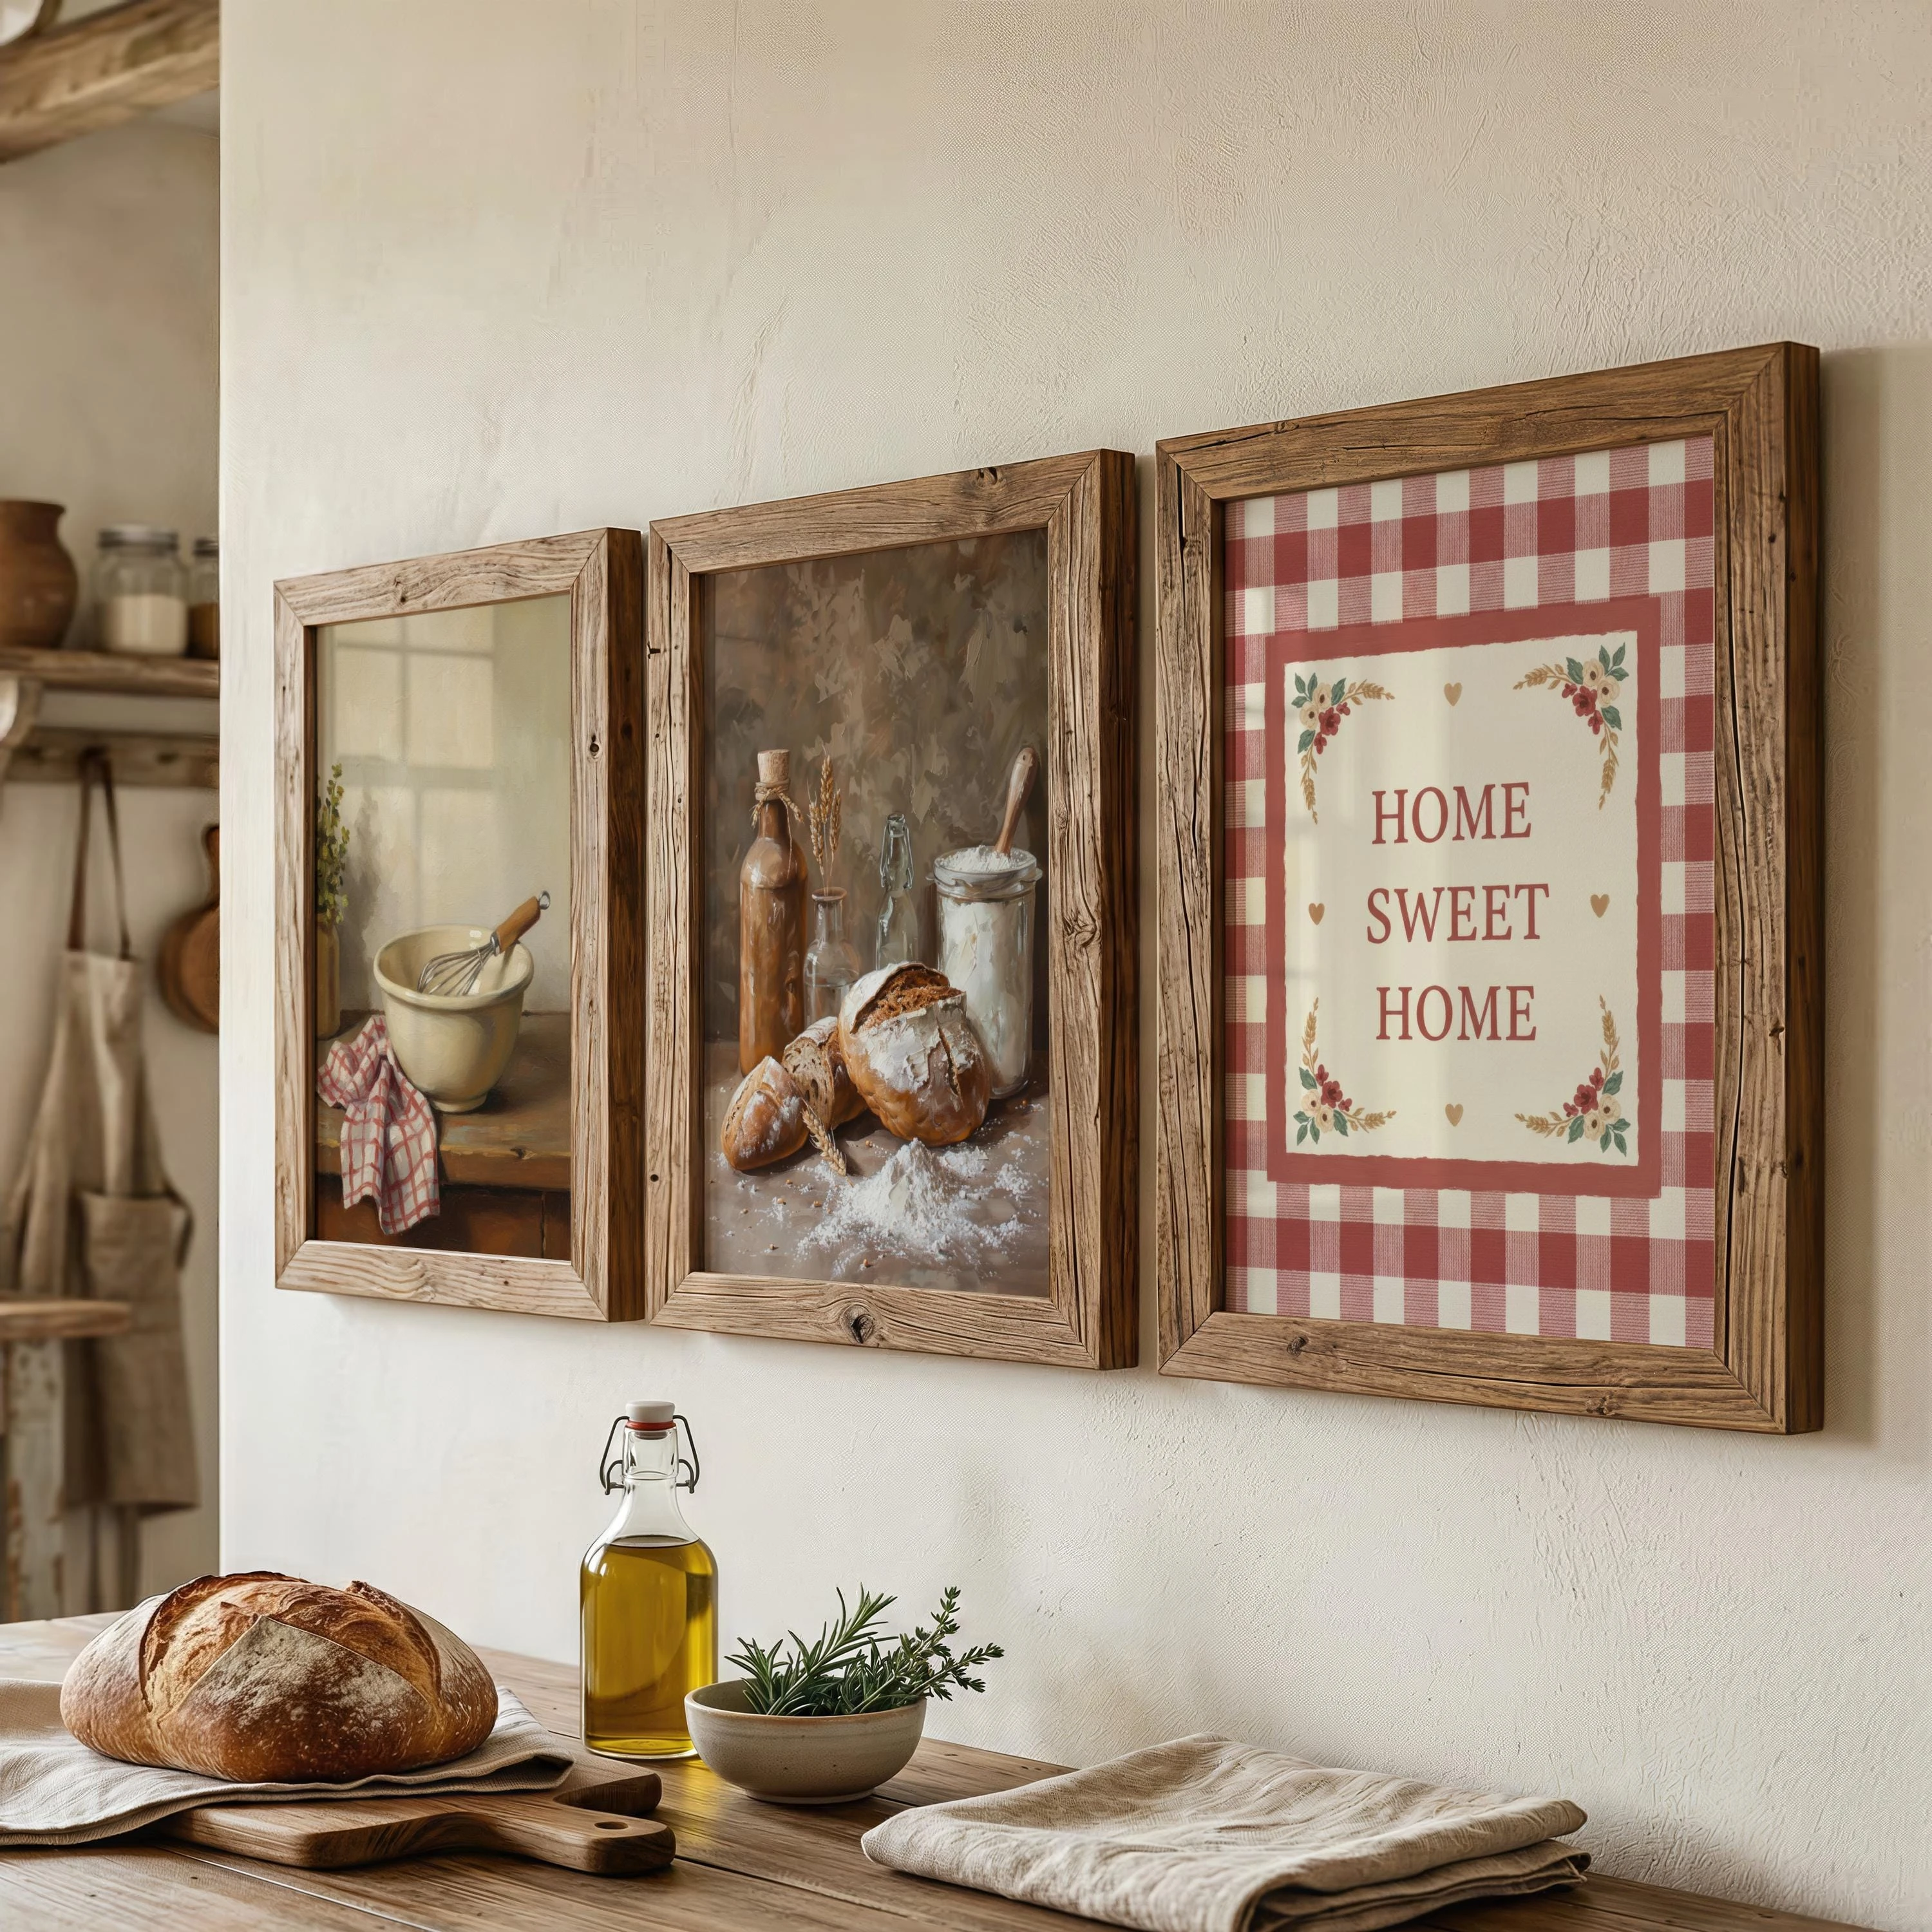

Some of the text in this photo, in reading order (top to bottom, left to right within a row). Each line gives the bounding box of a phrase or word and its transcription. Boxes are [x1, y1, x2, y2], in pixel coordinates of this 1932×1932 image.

[1372, 781, 1532, 845] HOME
[1367, 883, 1550, 945] SWEET
[1376, 985, 1537, 1042] HOME
